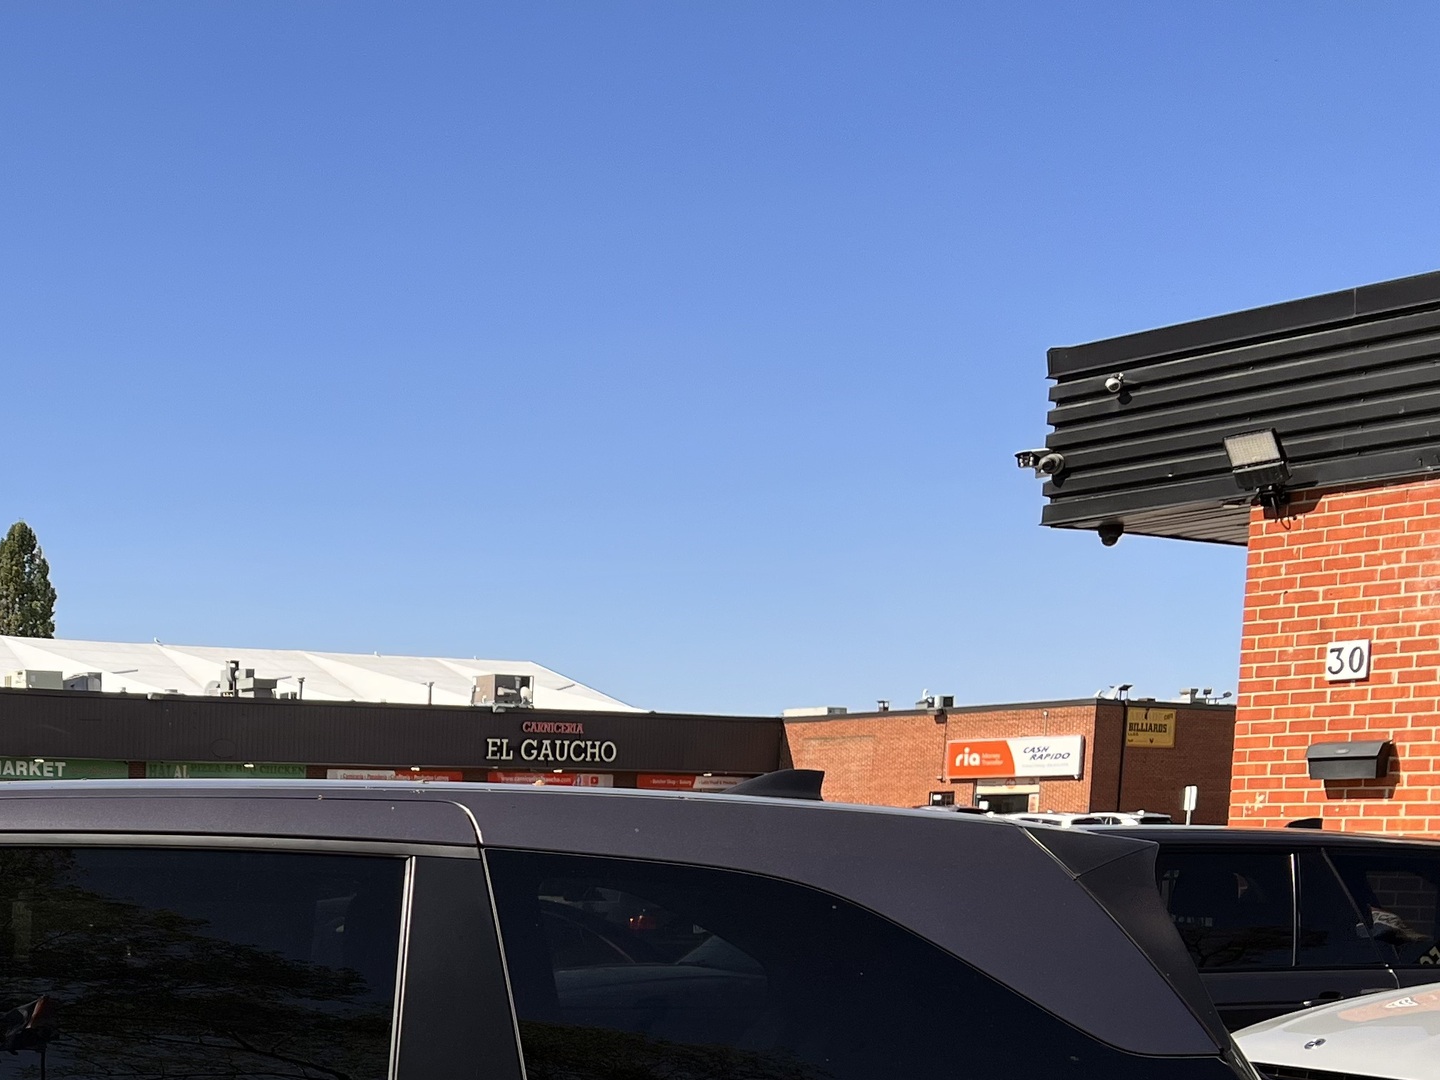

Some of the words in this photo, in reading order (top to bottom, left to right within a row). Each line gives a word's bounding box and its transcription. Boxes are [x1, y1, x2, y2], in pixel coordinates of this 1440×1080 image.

[1327, 646, 1365, 675] 30
[522, 721, 583, 734] CARNICERIA
[1128, 722, 1168, 733] BILLIARDS
[486, 738, 514, 760] EL
[520, 738, 617, 762] GAUCHO
[1023, 746, 1049, 754] CASH
[1029, 752, 1071, 760] RAPIDO
[955, 747, 981, 767] ria
[260, 765, 305, 775] CHICKEN
